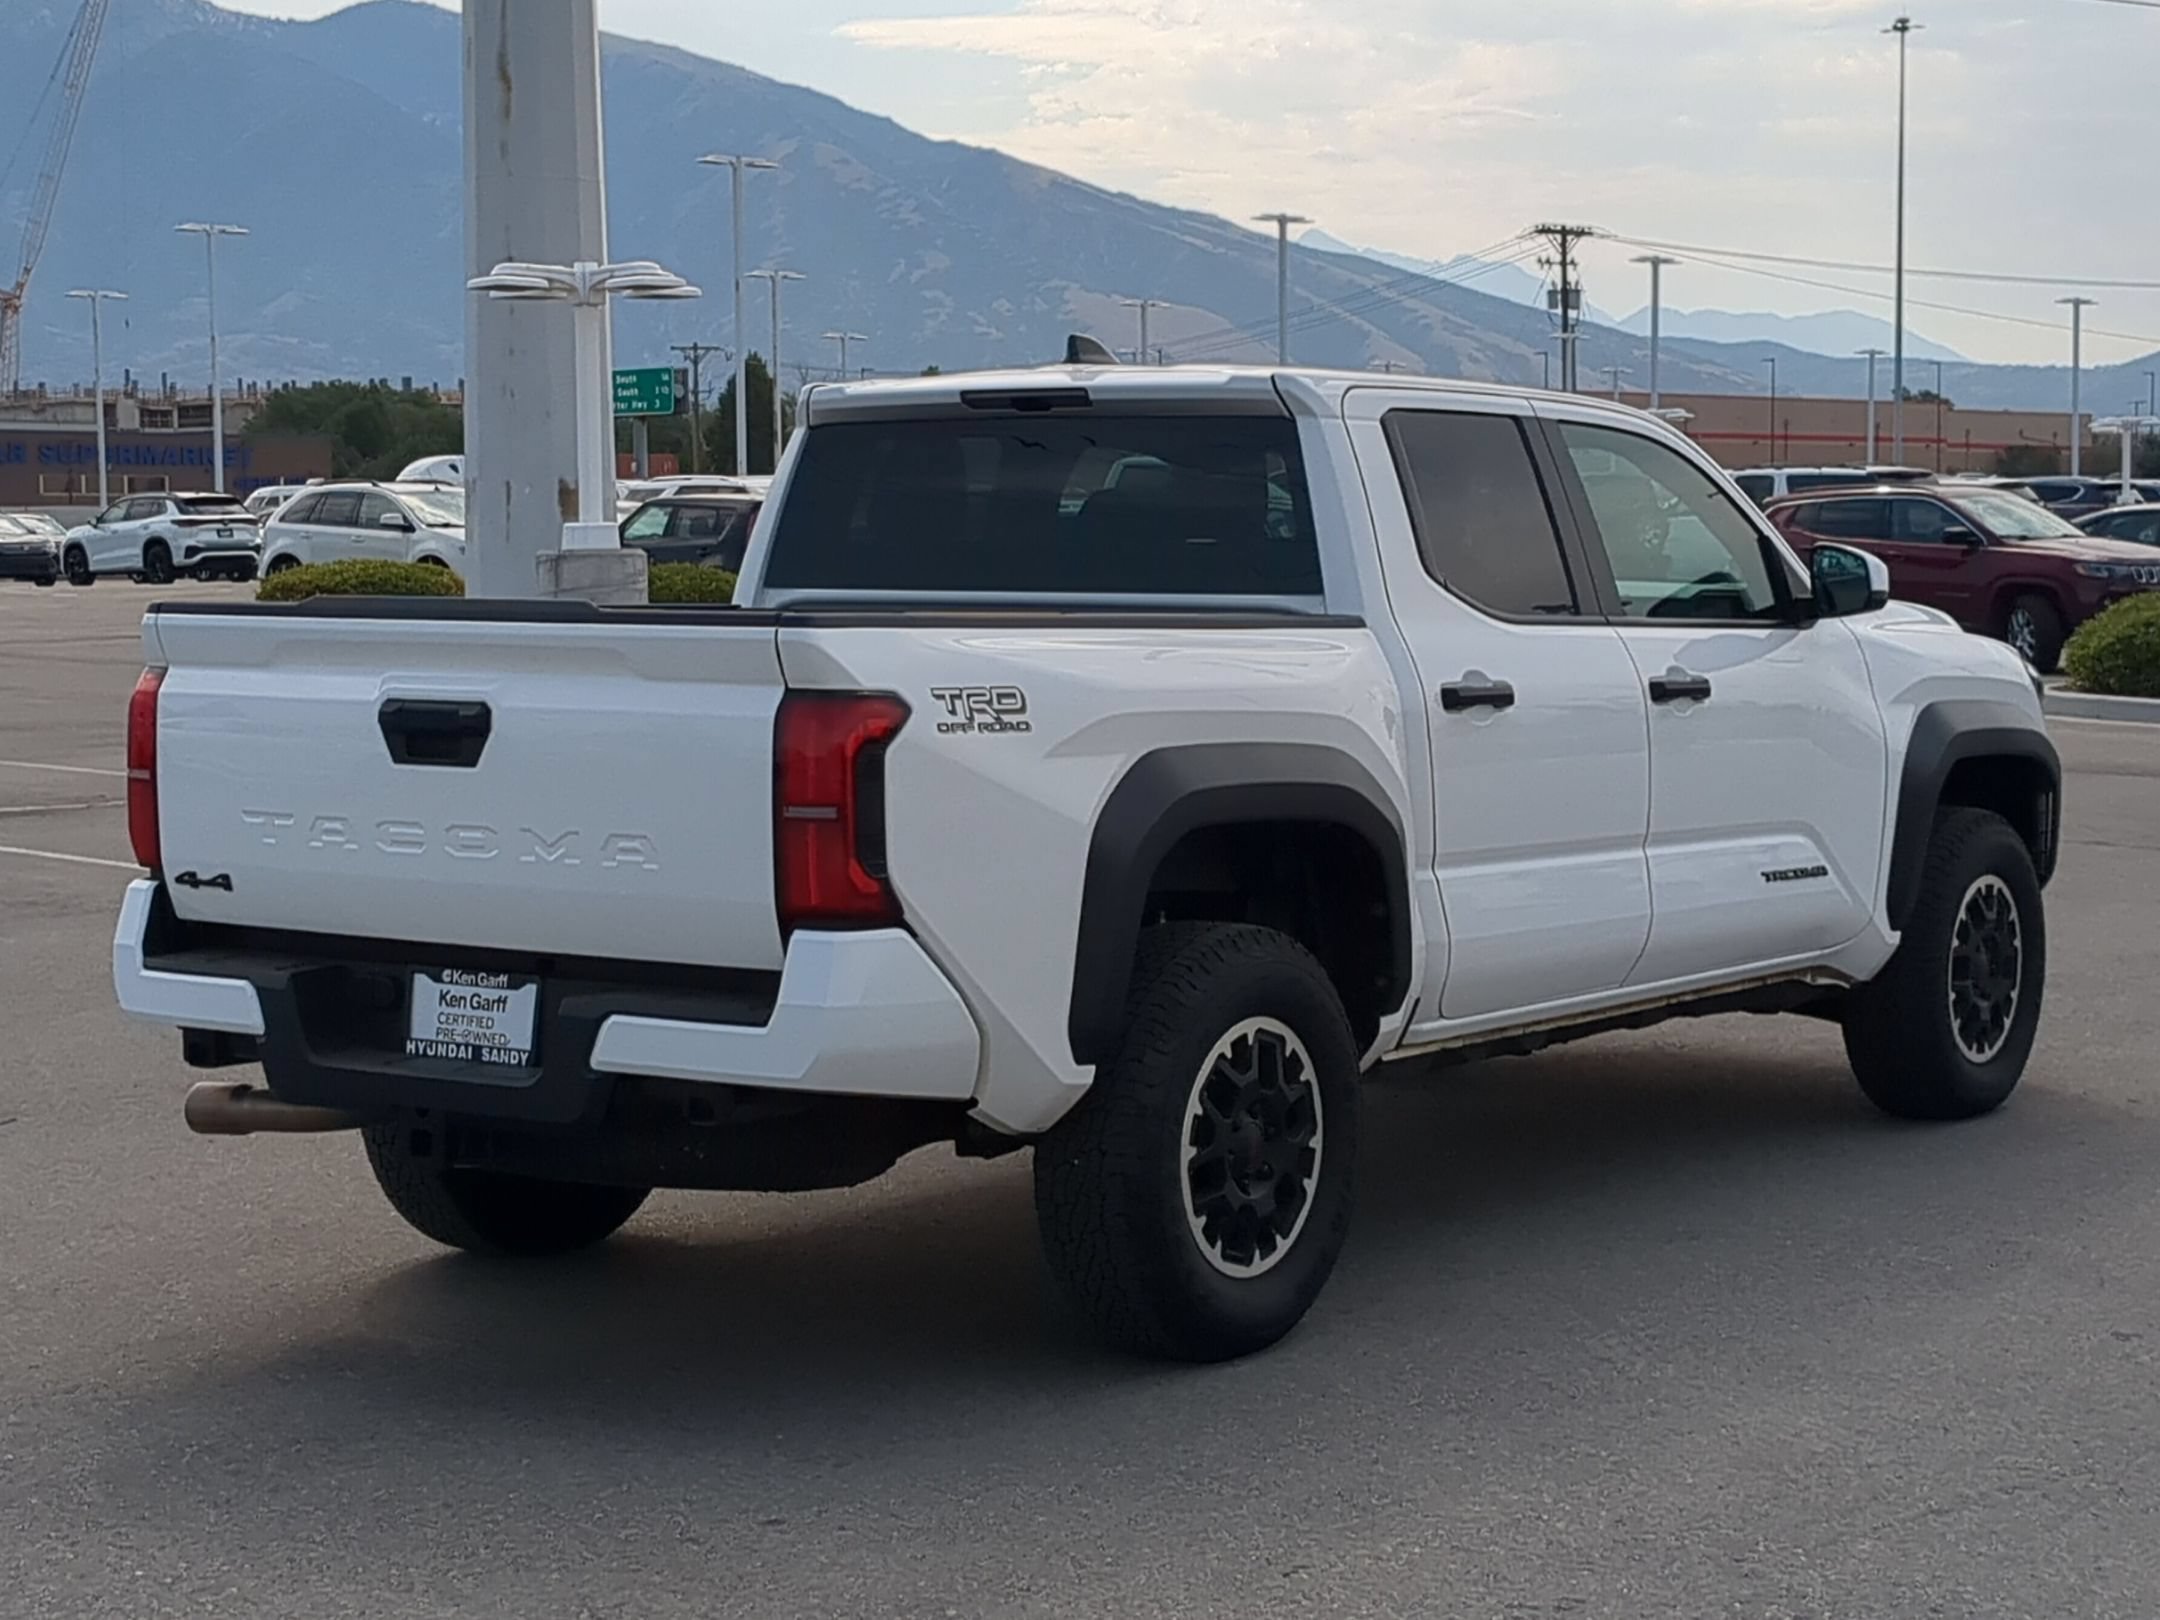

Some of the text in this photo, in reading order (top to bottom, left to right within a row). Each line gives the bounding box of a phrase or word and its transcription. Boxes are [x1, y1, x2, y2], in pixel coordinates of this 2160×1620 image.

[615, 374, 637, 384] South
[617, 387, 639, 397] South
[654, 399, 660, 408] 3
[930, 686, 1027, 722] TRD
[937, 721, 1032, 733] OFF ROAD
[241, 809, 660, 870] TACOMA
[452, 969, 509, 988] Ken Garff
[438, 989, 509, 1013] Ken Garff
[437, 1011, 495, 1030] CERTIFIED
[405, 1039, 529, 1067] HYUNDAI SANDY
